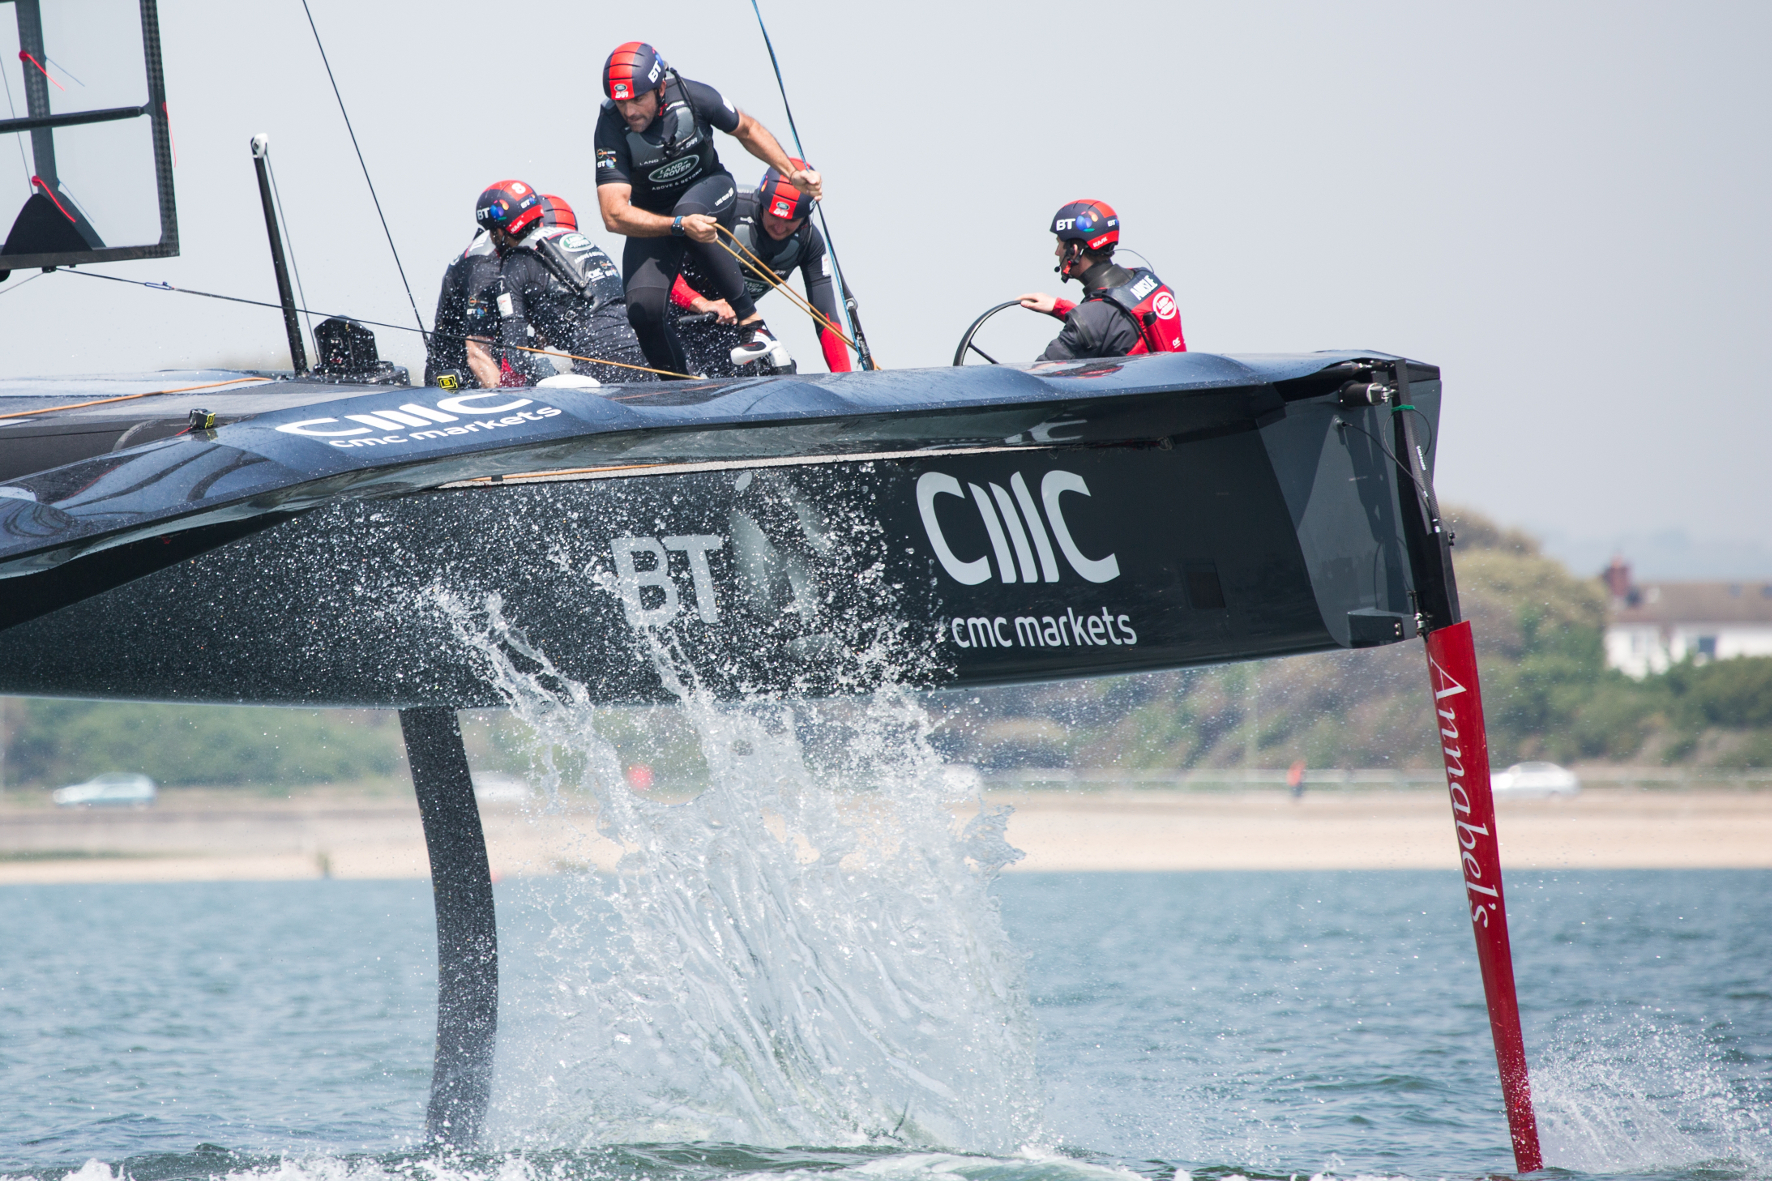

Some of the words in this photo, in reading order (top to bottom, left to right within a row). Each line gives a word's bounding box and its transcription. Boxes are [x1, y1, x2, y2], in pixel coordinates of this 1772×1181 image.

[648, 60, 661, 84] BT
[660, 162, 683, 175] LAND
[662, 162, 692, 179] ROVER
[511, 182, 526, 194] 8
[477, 206, 490, 221] BT
[1056, 218, 1076, 232] BT
[328, 434, 408, 448] cmc
[409, 406, 562, 440] markets
[610, 533, 723, 628] BT
[951, 616, 1013, 648] cmc
[1014, 606, 1138, 647] markets
[1429, 651, 1499, 928] Annabel's
